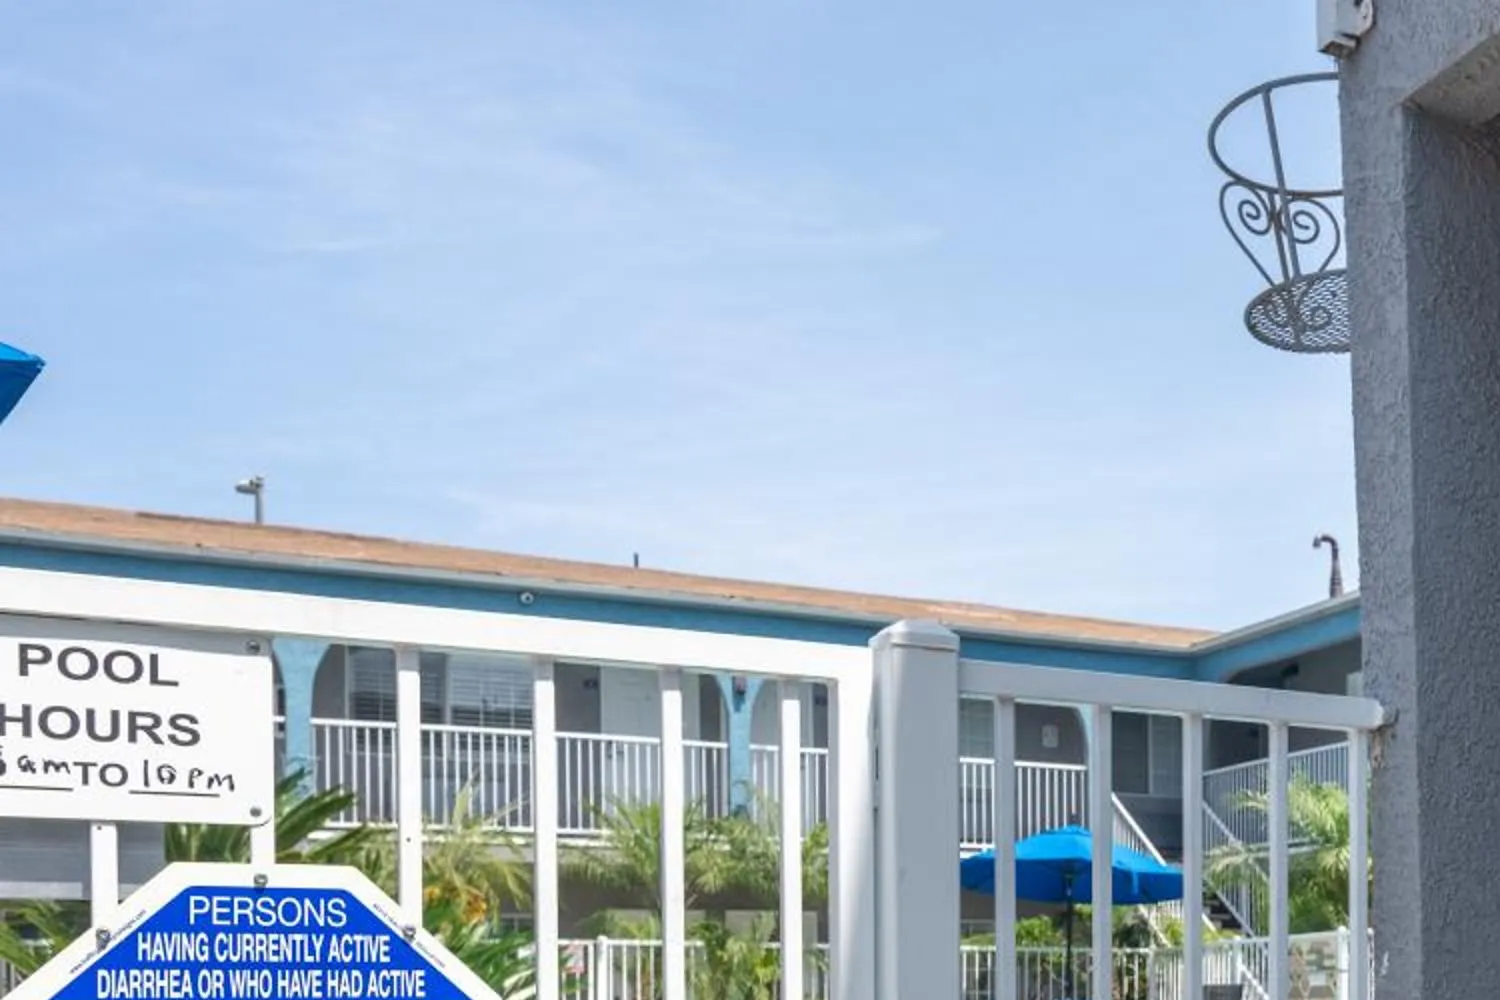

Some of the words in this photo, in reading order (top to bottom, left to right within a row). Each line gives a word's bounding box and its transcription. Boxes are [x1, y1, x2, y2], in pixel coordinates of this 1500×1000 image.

[18, 643, 179, 687] POOL
[0, 703, 201, 747] HOURS
[73, 762, 128, 787] TO
[190, 896, 346, 927] PERSONS
[138, 933, 208, 962] HAVING
[215, 933, 324, 962] CURRENTLY
[328, 934, 390, 962] ACTIVE
[98, 970, 193, 998] DIARRHEA
[198, 970, 224, 998] OR
[229, 970, 272, 998] WHO
[278, 970, 322, 998] HAVE
[327, 970, 362, 997] HAD
[368, 970, 425, 997] ACTIVE
